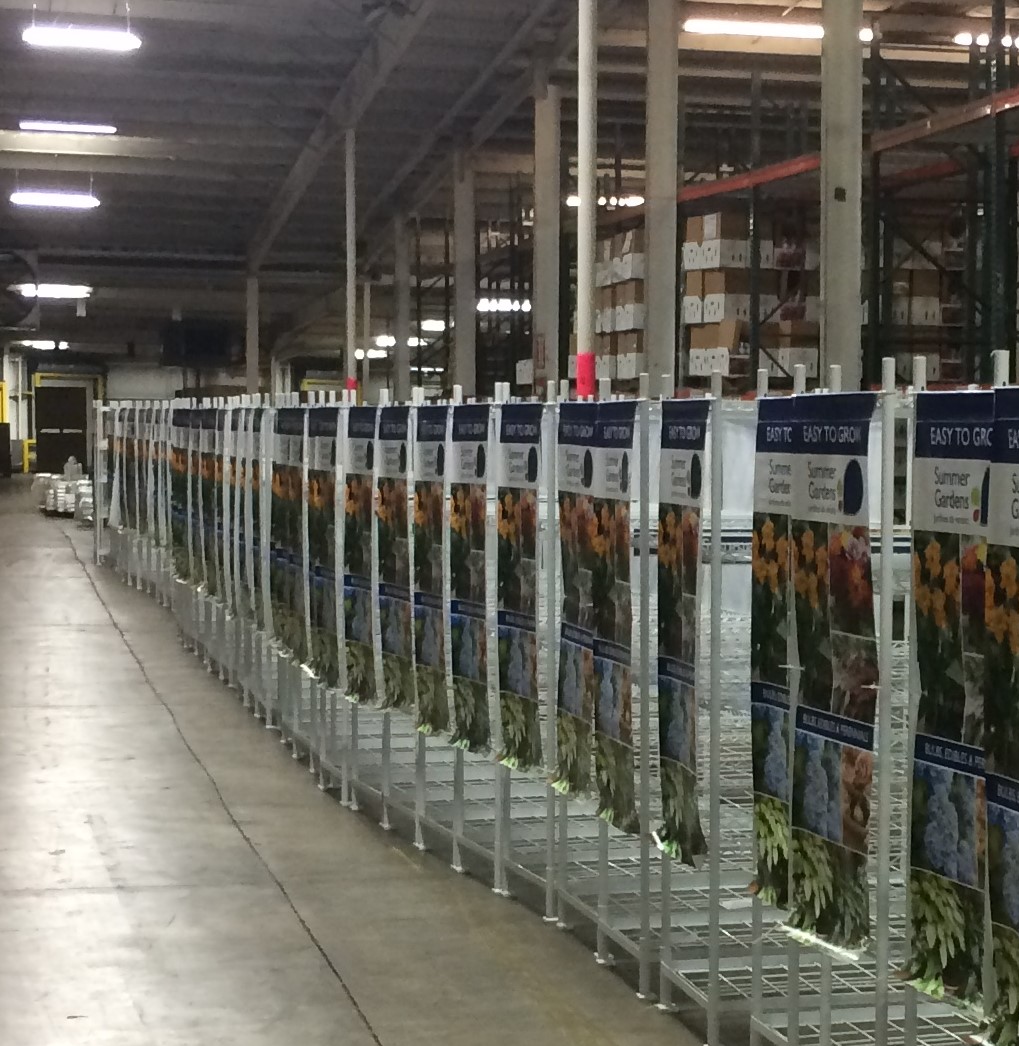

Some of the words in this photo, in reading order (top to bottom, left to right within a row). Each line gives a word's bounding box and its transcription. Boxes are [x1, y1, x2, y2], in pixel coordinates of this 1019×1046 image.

[803, 425, 823, 442] EASY
[823, 425, 837, 443] TO
[930, 427, 953, 446] EASY
[955, 427, 970, 446] TO
[972, 427, 994, 447] GRO
[933, 466, 971, 487] Summer
[934, 488, 970, 510] Gardens
